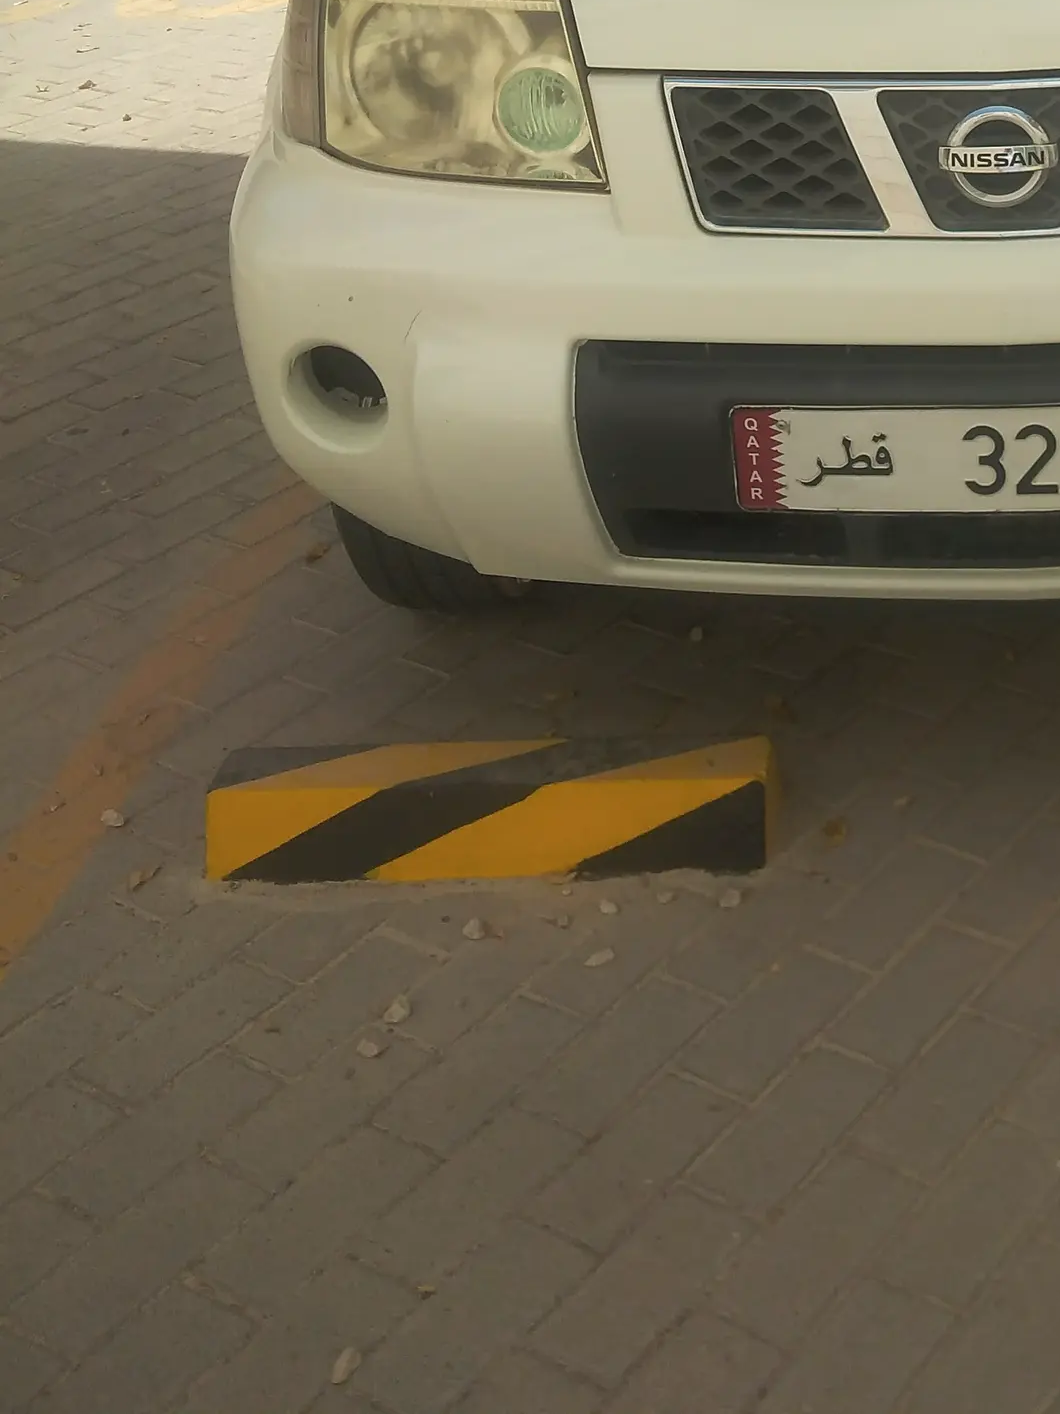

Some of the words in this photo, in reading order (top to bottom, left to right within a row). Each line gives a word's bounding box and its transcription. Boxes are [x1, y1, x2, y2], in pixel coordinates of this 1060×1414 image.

[951, 150, 1045, 168] NISSAN
[743, 417, 764, 500] QATAR
[796, 432, 894, 487] قطر
